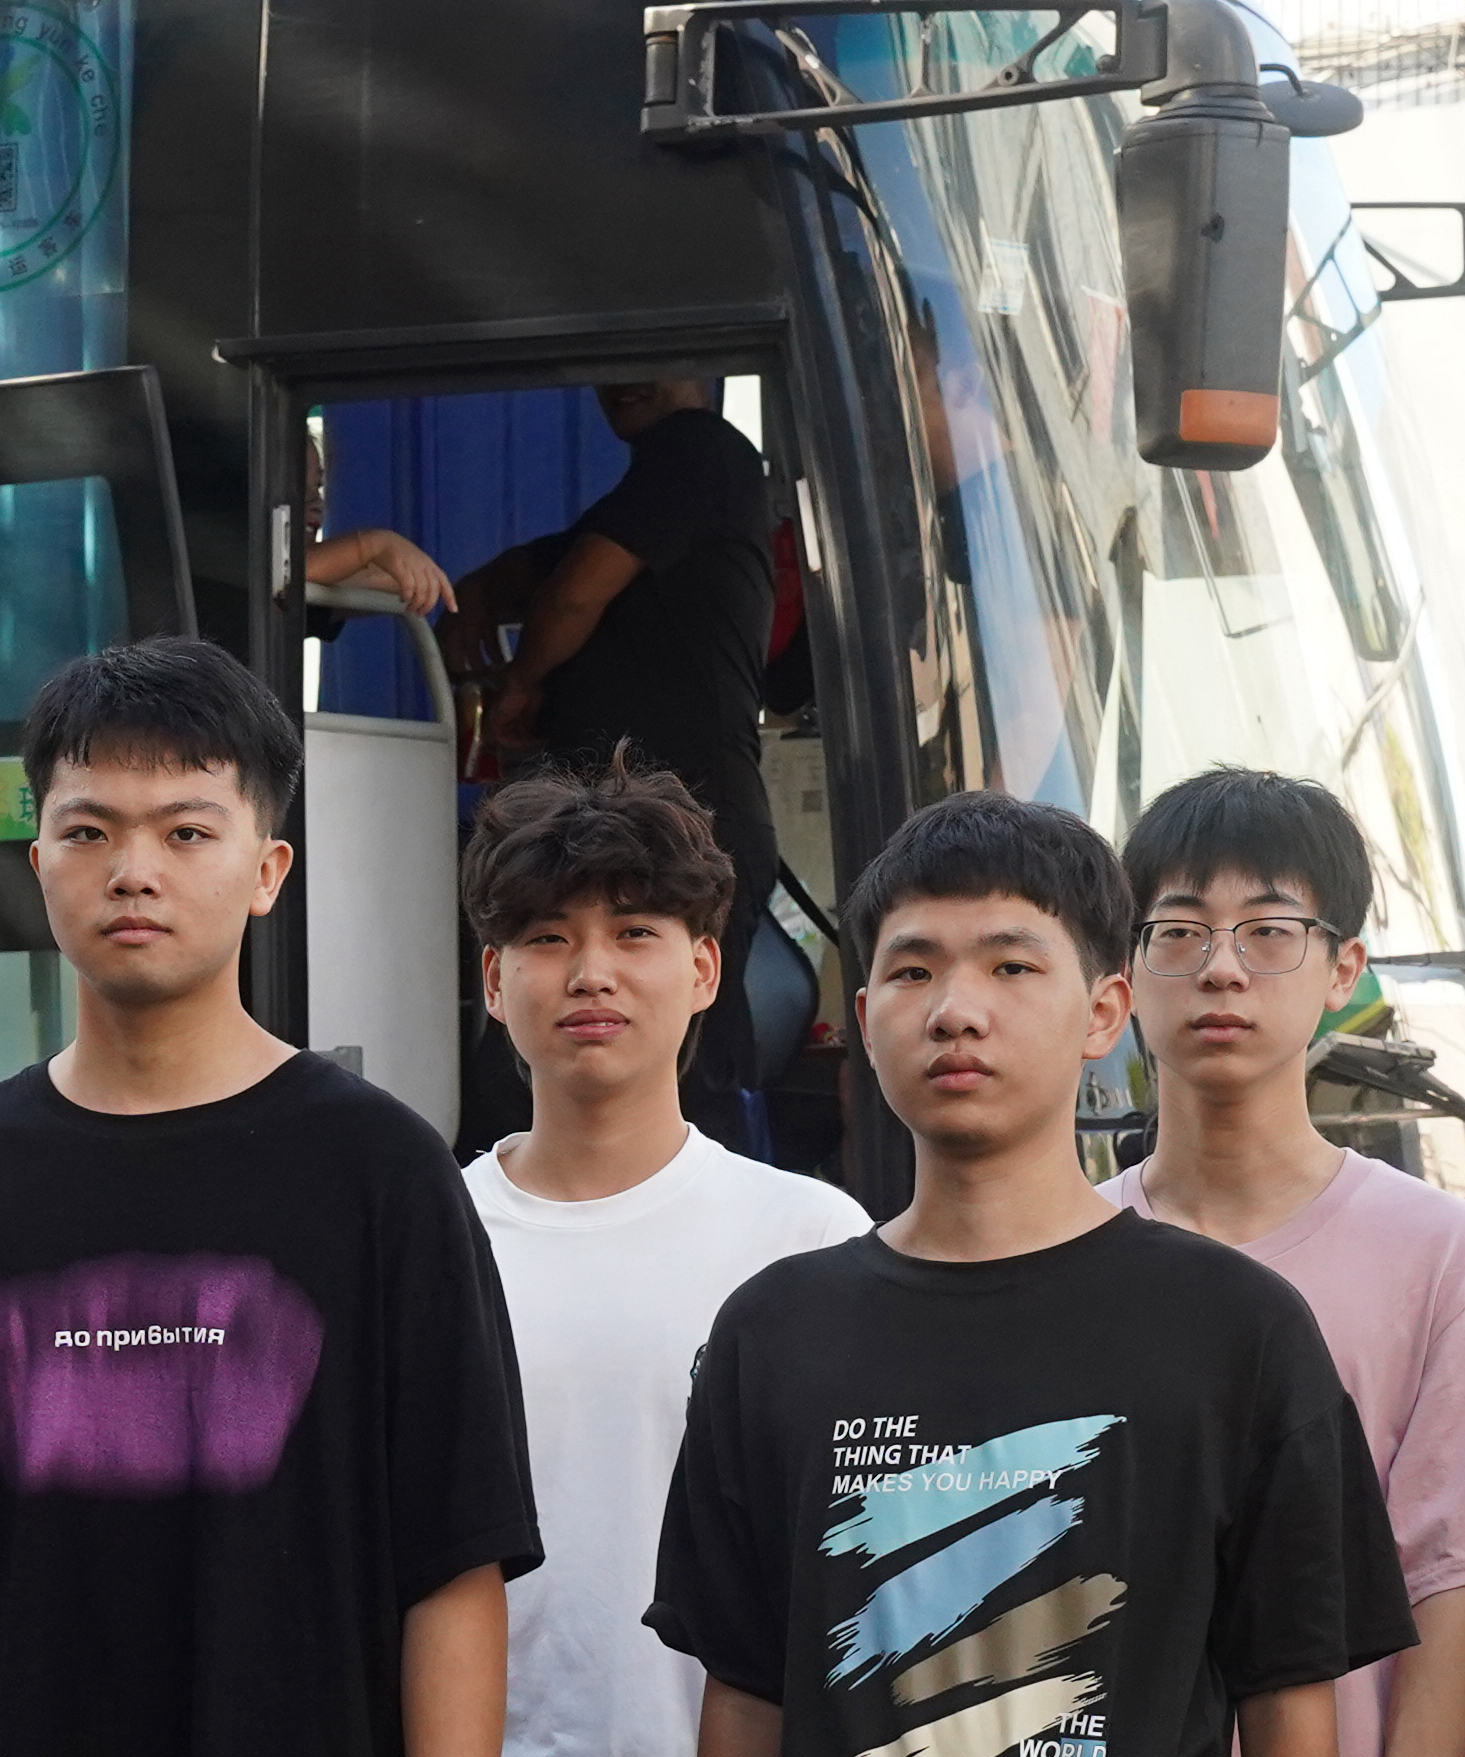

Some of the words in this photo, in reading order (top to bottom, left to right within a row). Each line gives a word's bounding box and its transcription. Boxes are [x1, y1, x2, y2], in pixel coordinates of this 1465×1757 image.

[833, 1417, 866, 1441] DO
[873, 1415, 919, 1439] THE
[833, 1445, 901, 1466] THING
[908, 1444, 971, 1465] THAT
[832, 1472, 914, 1495] MAKES
[921, 1472, 972, 1491] YOU
[979, 1470, 1065, 1492] HAPPY
[1058, 1713, 1106, 1737] THE
